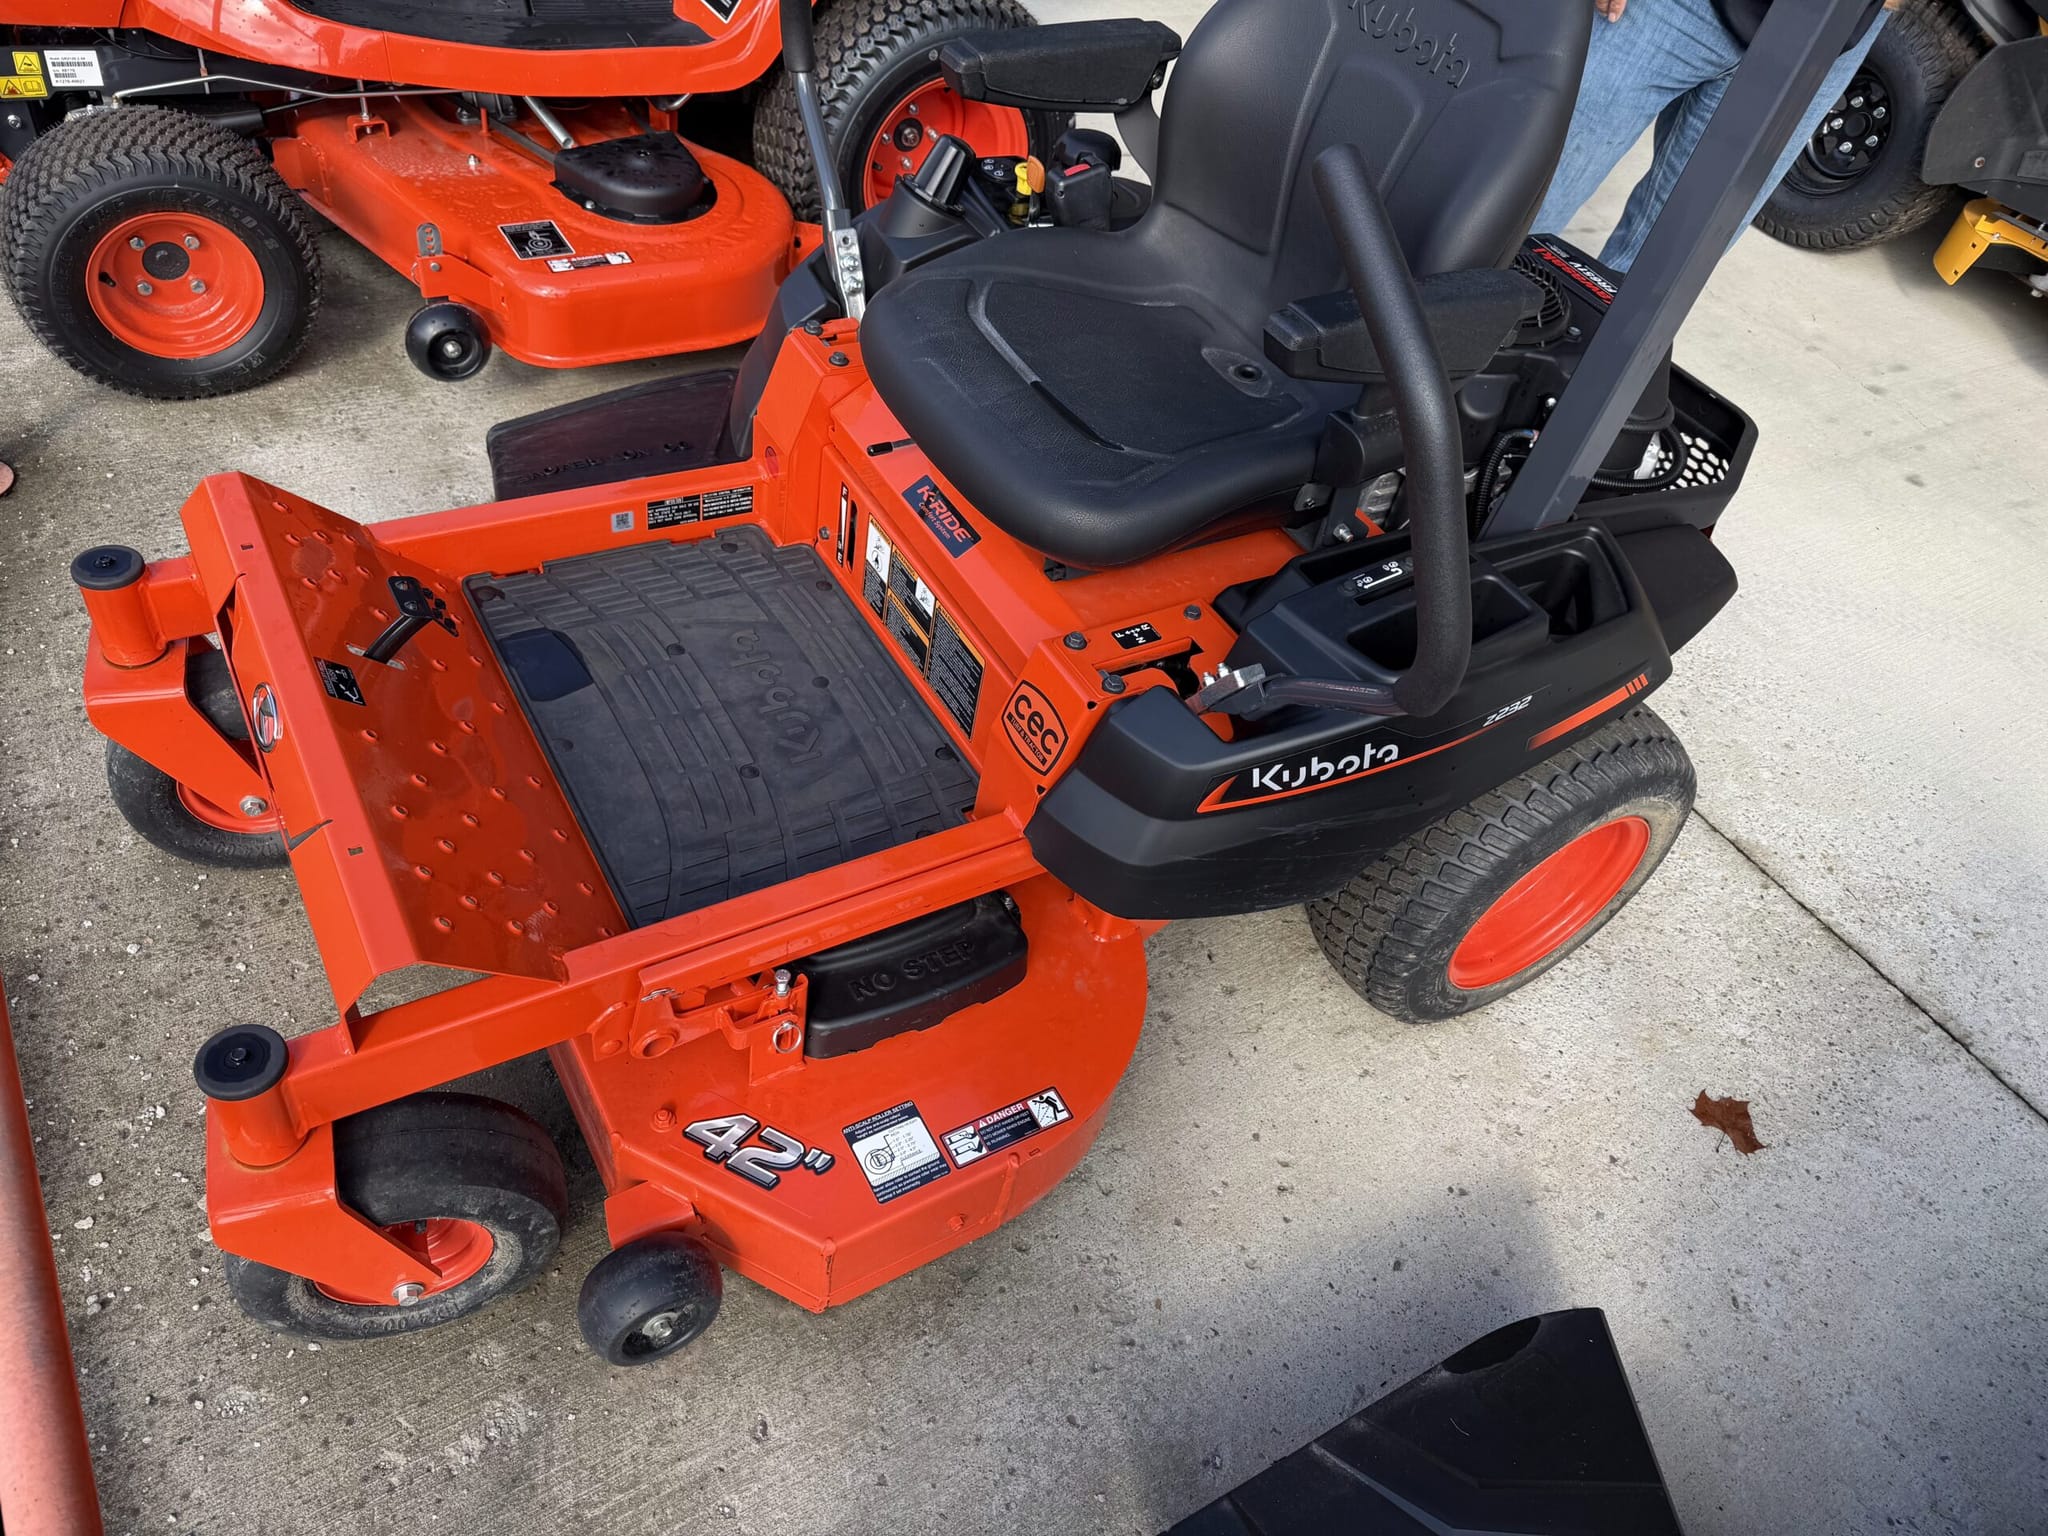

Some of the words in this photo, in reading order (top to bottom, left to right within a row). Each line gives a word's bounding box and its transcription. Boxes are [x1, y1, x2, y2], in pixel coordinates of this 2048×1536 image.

[1349, 0, 1471, 89] Kubota
[916, 485, 971, 543] K-RIDE
[918, 502, 937, 524] Comfort
[934, 519, 951, 540] System
[1140, 623, 1151, 631] R
[1024, 735, 1045, 761] TRACTOR
[1252, 742, 1399, 791] Kubota
[848, 970, 898, 1002] NO
[903, 942, 975, 979] STEP
[891, 1100, 914, 1115] SETTING
[985, 1102, 1025, 1124] DANGER
[683, 1114, 836, 1190] 42"
